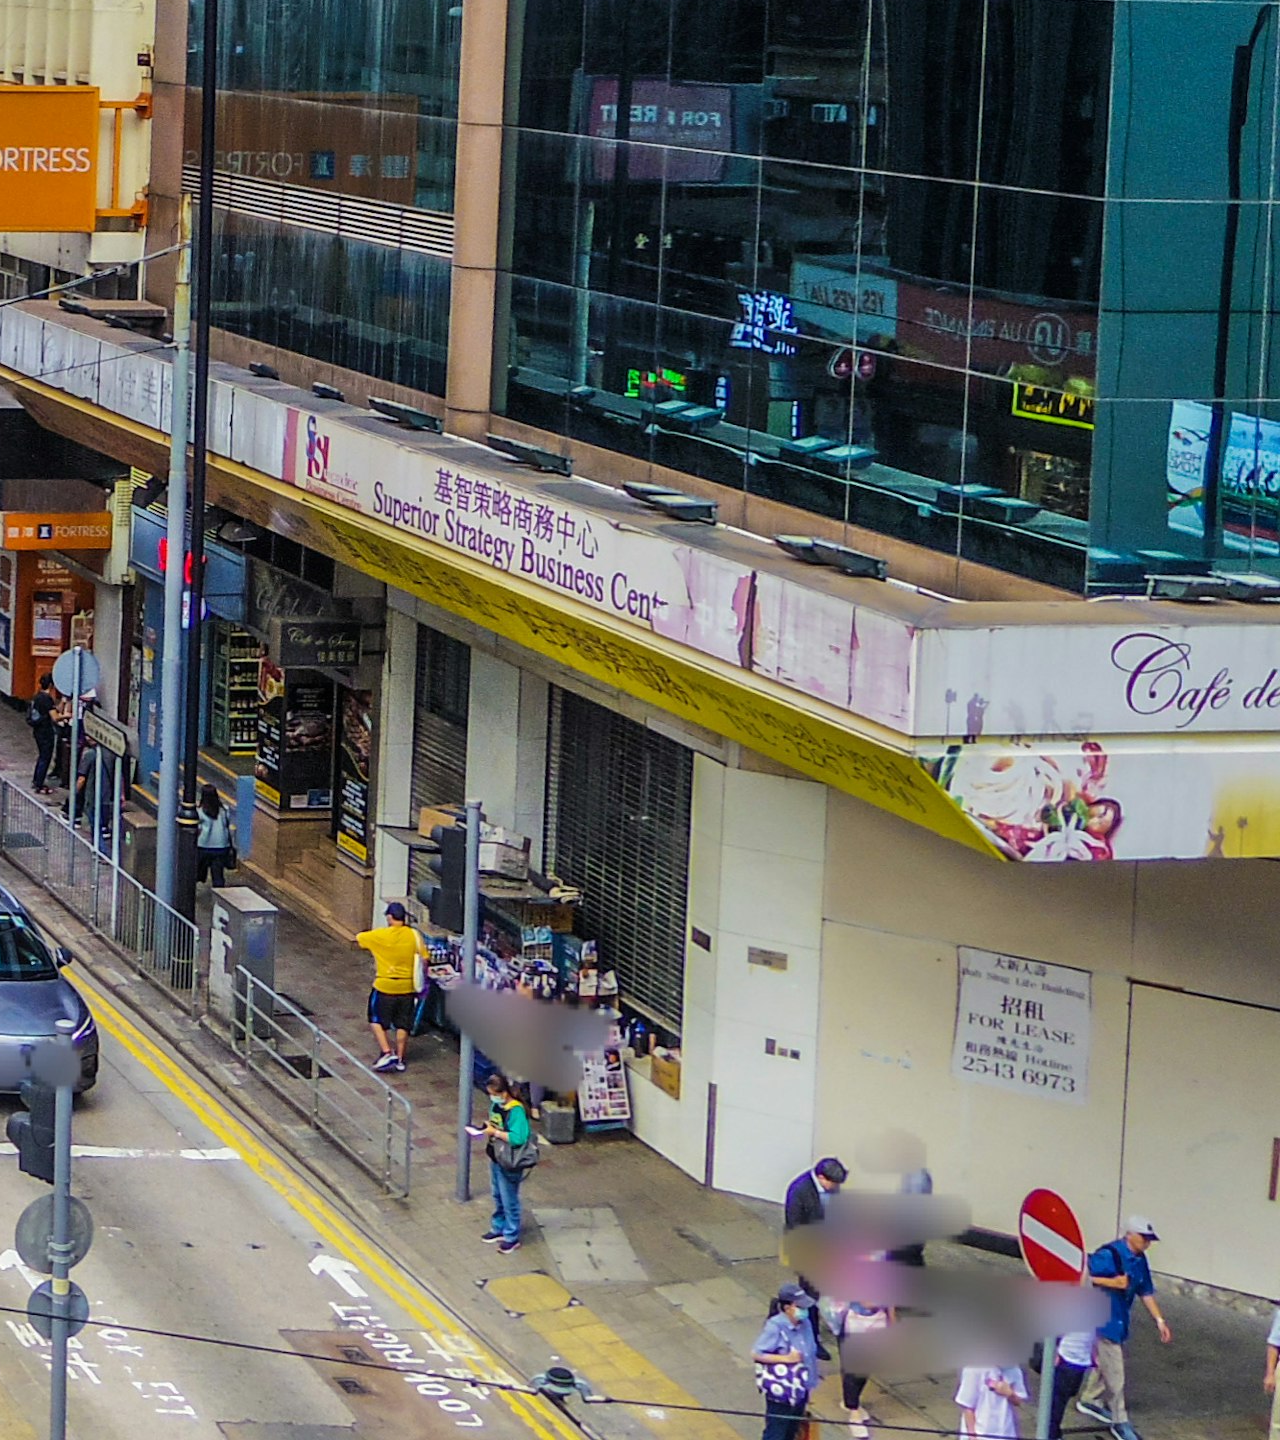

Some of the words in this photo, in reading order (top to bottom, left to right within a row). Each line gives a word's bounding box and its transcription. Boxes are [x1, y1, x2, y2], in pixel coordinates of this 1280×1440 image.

[433, 466, 600, 560] 基智策略商務中心
[55, 525, 109, 538] FORTRESS
[372, 480, 441, 538] Superior
[443, 506, 516, 572] Strategy
[520, 536, 605, 603] Business
[1110, 632, 1233, 729] Café
[1243, 668, 1280, 710] de
[1000, 994, 1045, 1022] 招租
[1042, 982, 1086, 1001] Building
[968, 1012, 1005, 1031] FOR
[1015, 1021, 1076, 1046] LEASE
[962, 1055, 1015, 1081] 2543
[1021, 1069, 1076, 1093] 6973
[1025, 1054, 1073, 1071] Hotline
[403, 1367, 484, 1428] LOOK
